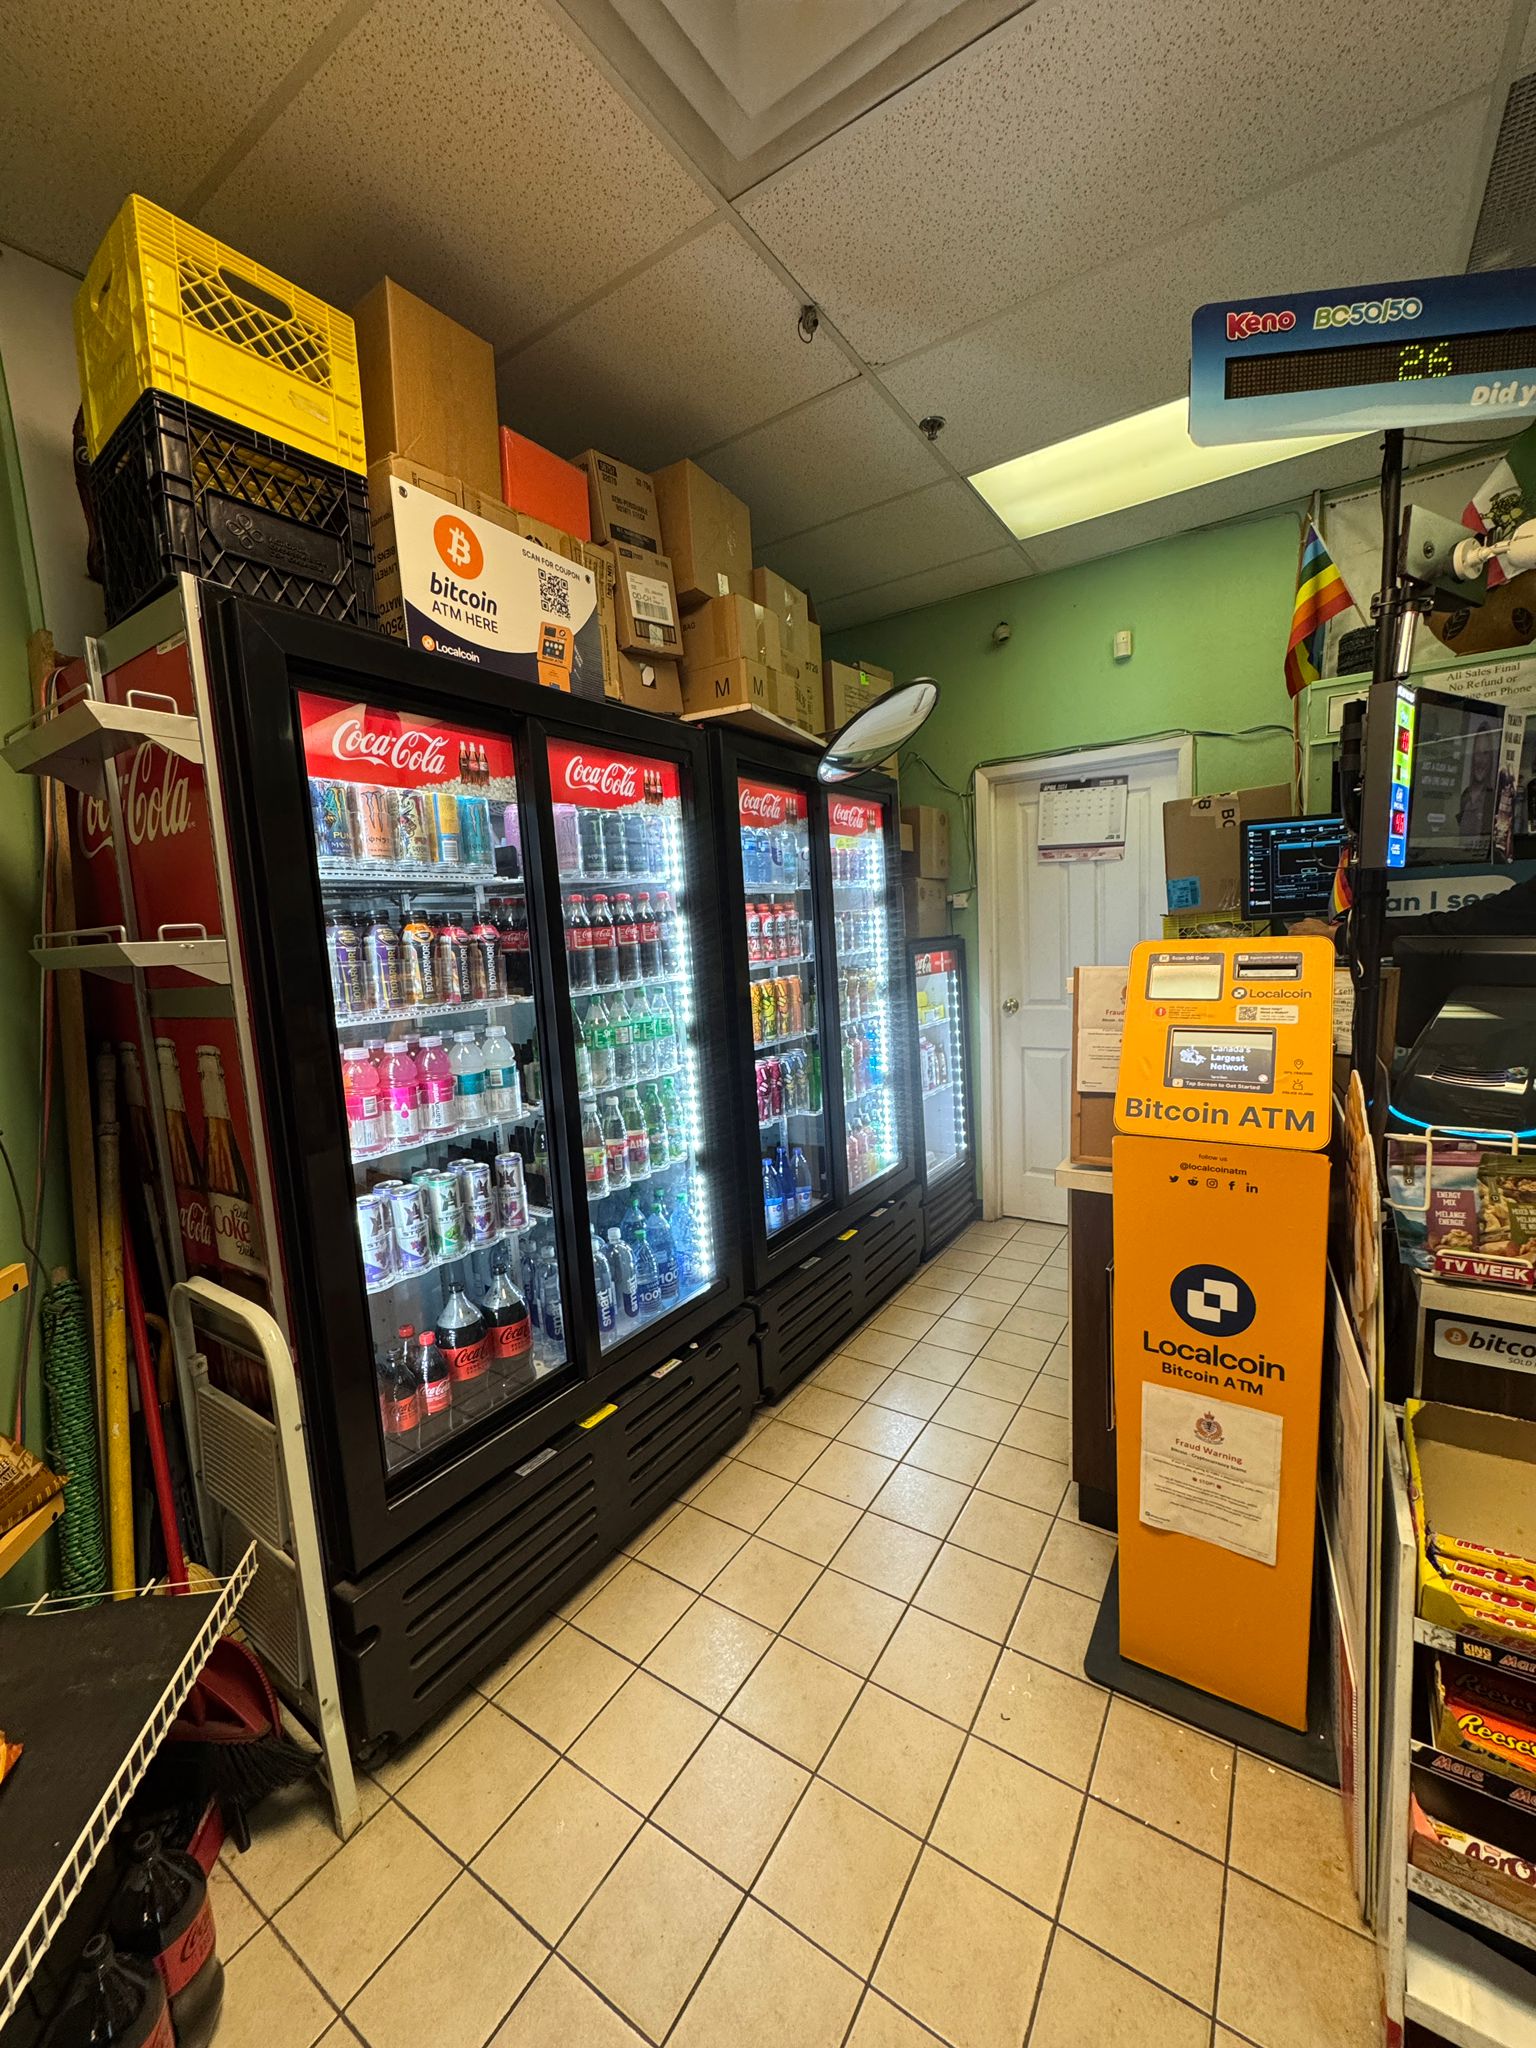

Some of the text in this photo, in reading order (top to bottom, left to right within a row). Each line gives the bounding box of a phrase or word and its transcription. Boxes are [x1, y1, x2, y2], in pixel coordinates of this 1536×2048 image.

[1226, 311, 1296, 341] Keno
[1398, 342, 1453, 382] 26
[1471, 381, 1518, 406] Did
[521, 548, 581, 581] SCAN FOR COUPON
[430, 572, 498, 616] bitcoin
[432, 601, 499, 634] ATM HERE
[435, 640, 480, 664] Localcoin
[1447, 663, 1520, 681] All Sales Final
[1449, 684, 1463, 692] No
[1466, 676, 1503, 690] Refund
[715, 677, 731, 698] M
[753, 676, 764, 697] M
[1500, 684, 1532, 696] Phone
[332, 719, 449, 775] Coca-Cola
[565, 755, 639, 798] Coca-Cola
[739, 788, 782, 820] Coca-Cola
[832, 802, 866, 829] Coca-Cola
[1387, 895, 1420, 911] an
[1249, 988, 1312, 999] Localcoin
[1210, 1053, 1245, 1063] Largest
[1210, 1063, 1249, 1072] Network
[1125, 1097, 1315, 1133] Bitcoin ATM
[1179, 1161, 1248, 1176] @localcoinatm
[213, 1205, 251, 1244] Coke
[1441, 1258, 1529, 1282] TV WEEK
[598, 1289, 612, 1327] smart
[1143, 1330, 1286, 1383] Localcoin
[1468, 1331, 1536, 1358] bitco
[1508, 1357, 1532, 1367] SOLD
[1161, 1362, 1264, 1396] Bitcoin ATM
[1175, 1438, 1243, 1466] Fraud Warning
[1463, 1642, 1492, 1656] KING
[1458, 1714, 1536, 1759] Reese's
[1431, 1755, 1485, 1782] Mars
